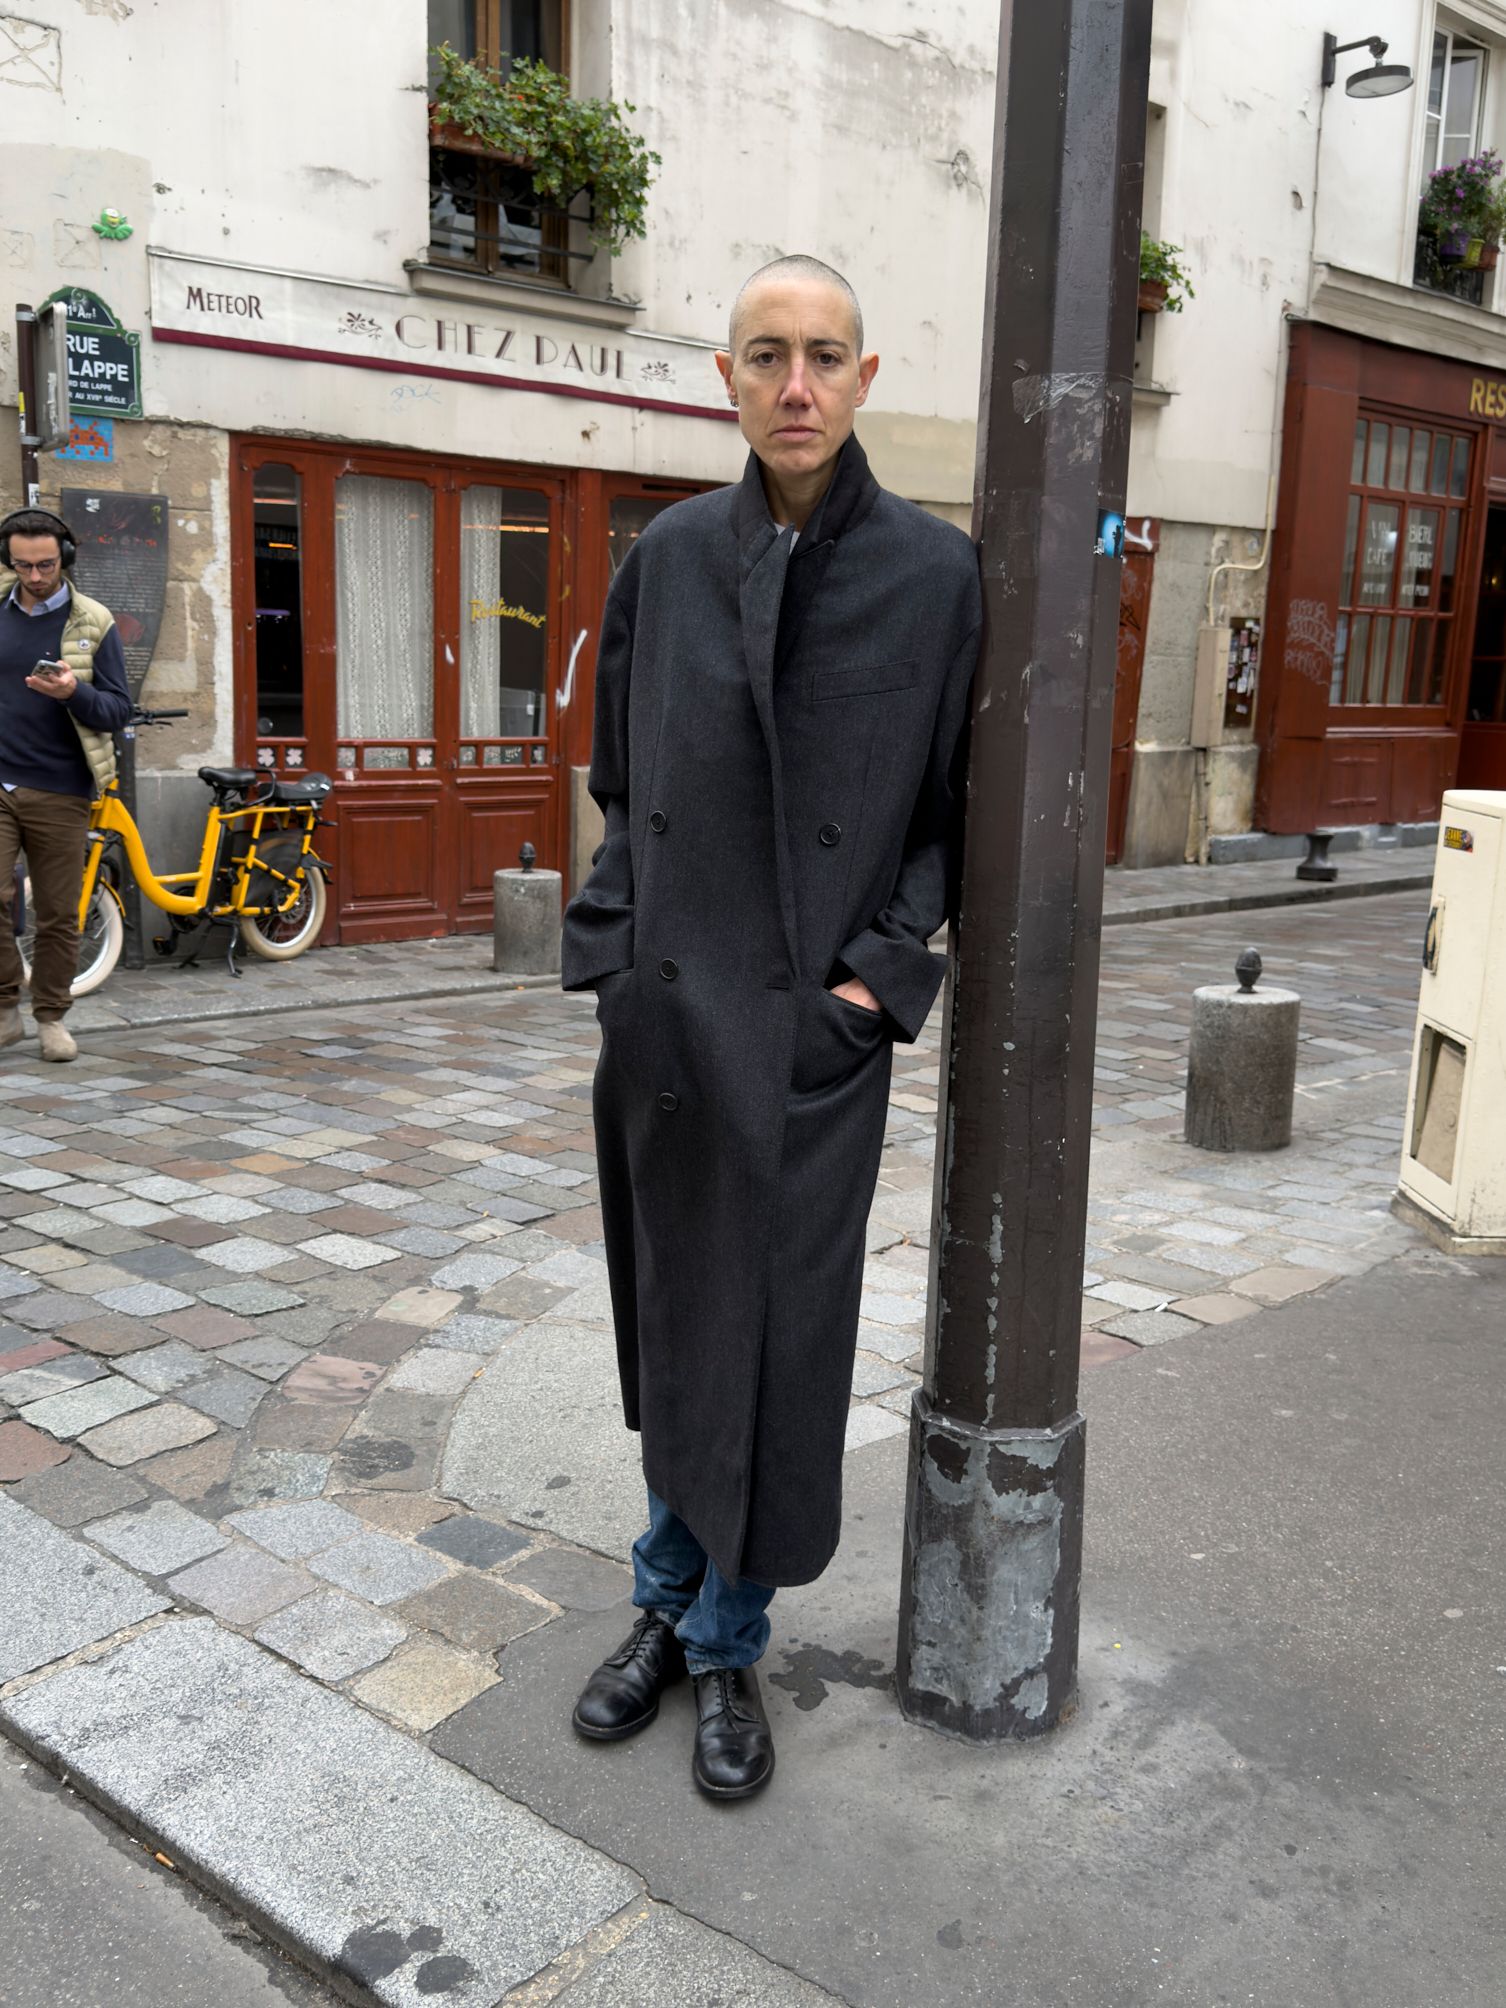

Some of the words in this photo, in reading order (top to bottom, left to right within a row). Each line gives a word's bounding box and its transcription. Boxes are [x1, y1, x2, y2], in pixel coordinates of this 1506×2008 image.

[186, 286, 264, 320] METEOR
[66, 334, 100, 355] RUE
[395, 314, 517, 362] CHEZ
[68, 358, 129, 381] LAPPE
[91, 383, 113, 391] LAPPE
[1470, 378, 1506, 418] RES
[469, 597, 546, 628] Restaurant
